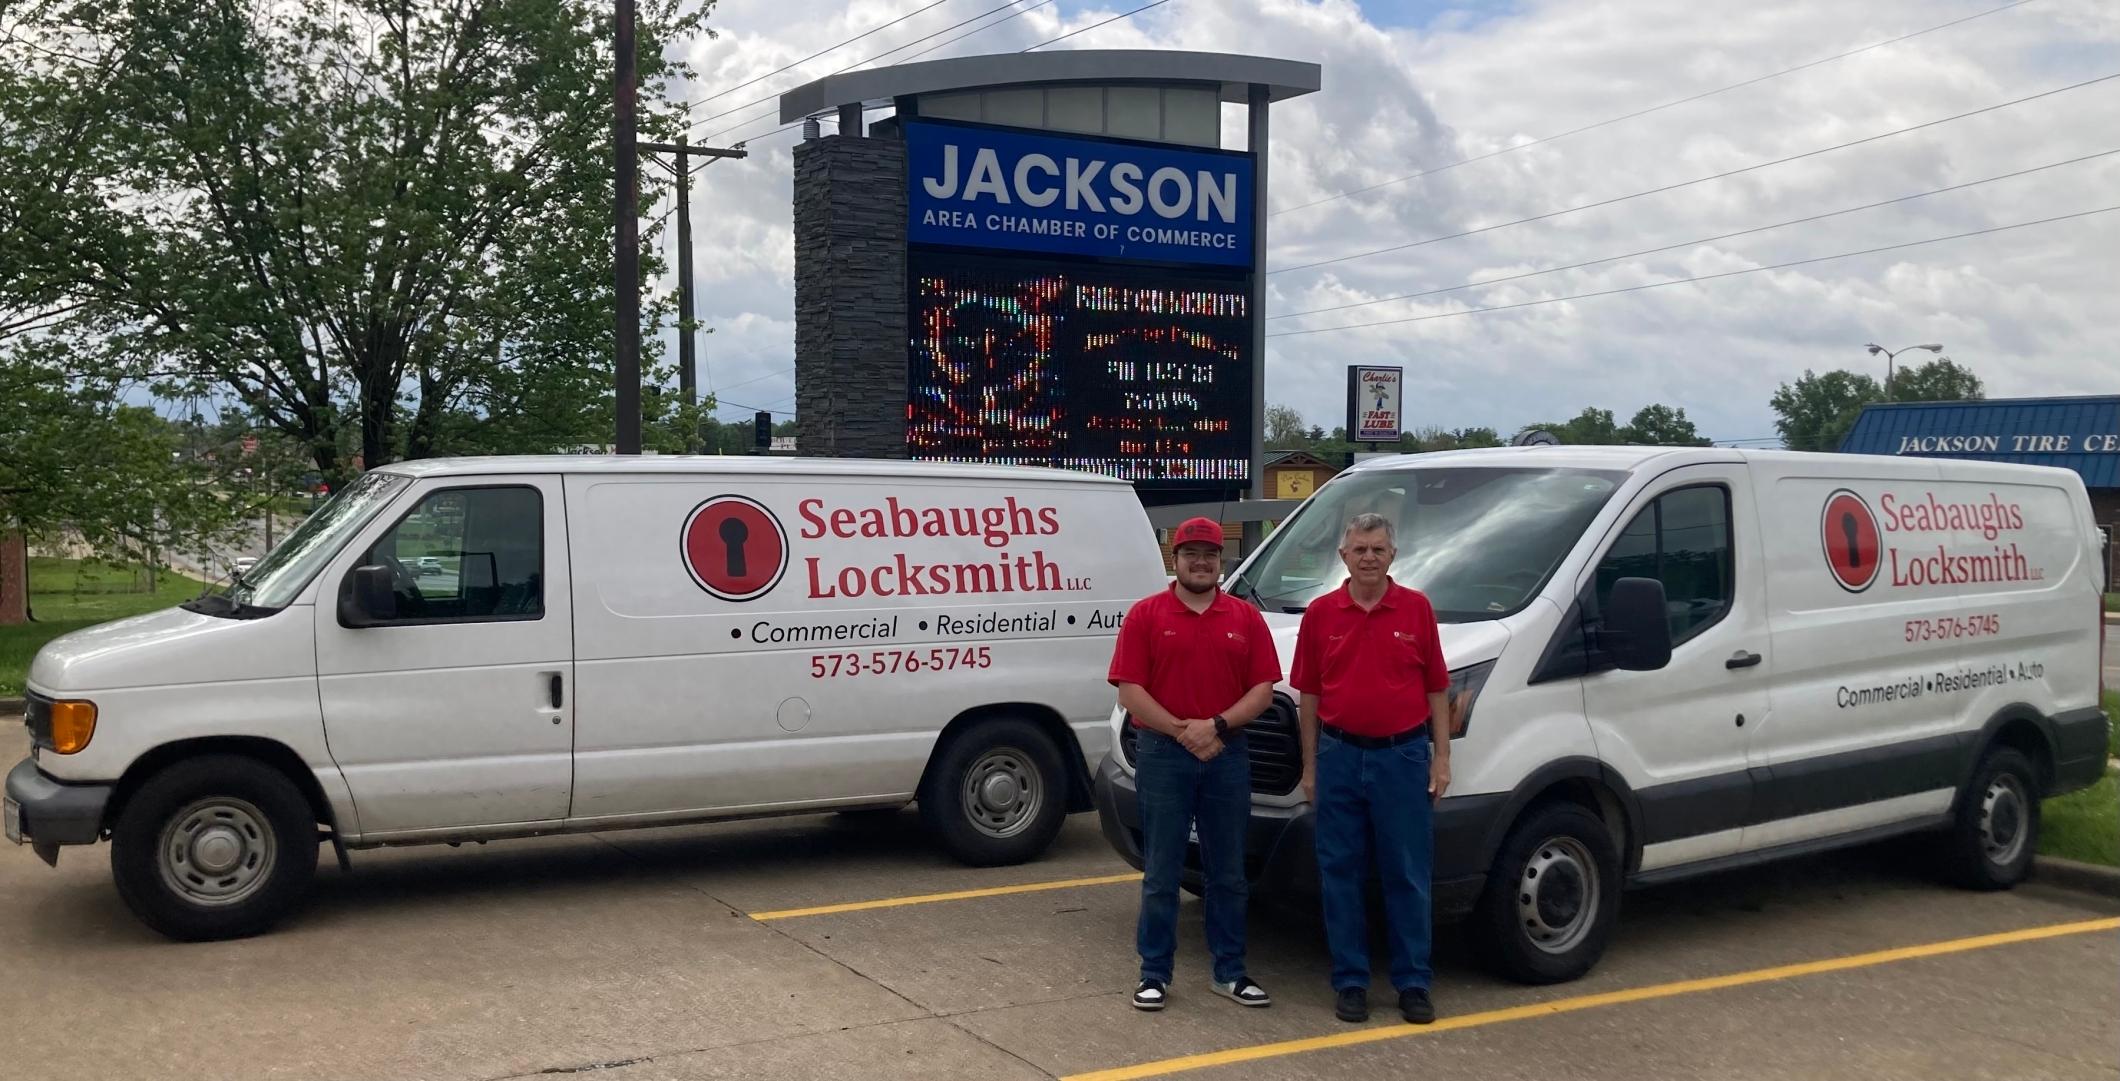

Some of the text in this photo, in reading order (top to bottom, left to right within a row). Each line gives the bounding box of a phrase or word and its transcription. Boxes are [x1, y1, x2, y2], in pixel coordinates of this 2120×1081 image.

[922, 144, 1237, 224] JACKSON
[923, 209, 1237, 249] AREA CHAMBER OF COMMERCE
[1362, 371, 1397, 383] Charlie's
[1363, 420, 1395, 429] LUBE
[1368, 411, 1391, 419] FAST
[1897, 434, 2120, 454] JACKSON TIRE CE
[799, 496, 1060, 547] Seabaughs
[1881, 493, 2023, 540] Seabaughs
[804, 551, 1092, 599] Locksmith LLC
[1889, 543, 2044, 586] Locksmith LLC
[751, 610, 1123, 644] Commercial Residential Aut
[1904, 614, 2000, 642] 573-576-5745
[810, 646, 992, 678] 573-576-5745
[1837, 661, 2044, 708] Commercial Residential Auto
